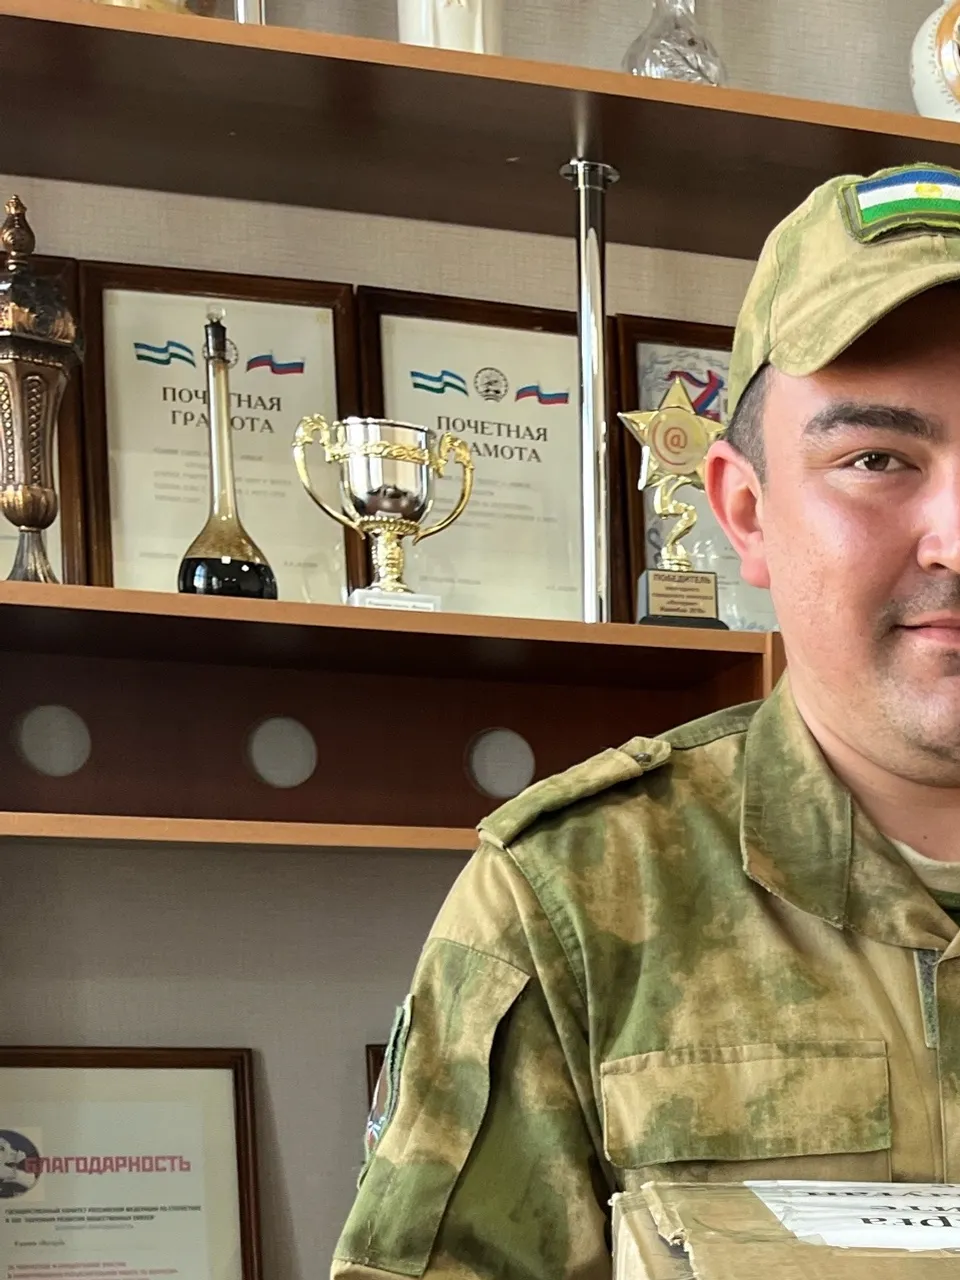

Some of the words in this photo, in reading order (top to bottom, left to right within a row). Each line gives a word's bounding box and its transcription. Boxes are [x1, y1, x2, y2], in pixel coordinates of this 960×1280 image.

[162, 386, 282, 412] ПОЧНАЯ
[171, 410, 275, 433] ГРАОТА
[436, 415, 548, 442] ПОЧЕТНАЯ
[470, 442, 542, 463] АМОТА
[24, 1154, 192, 1175] БЛАГОДАРНОСТЬ
